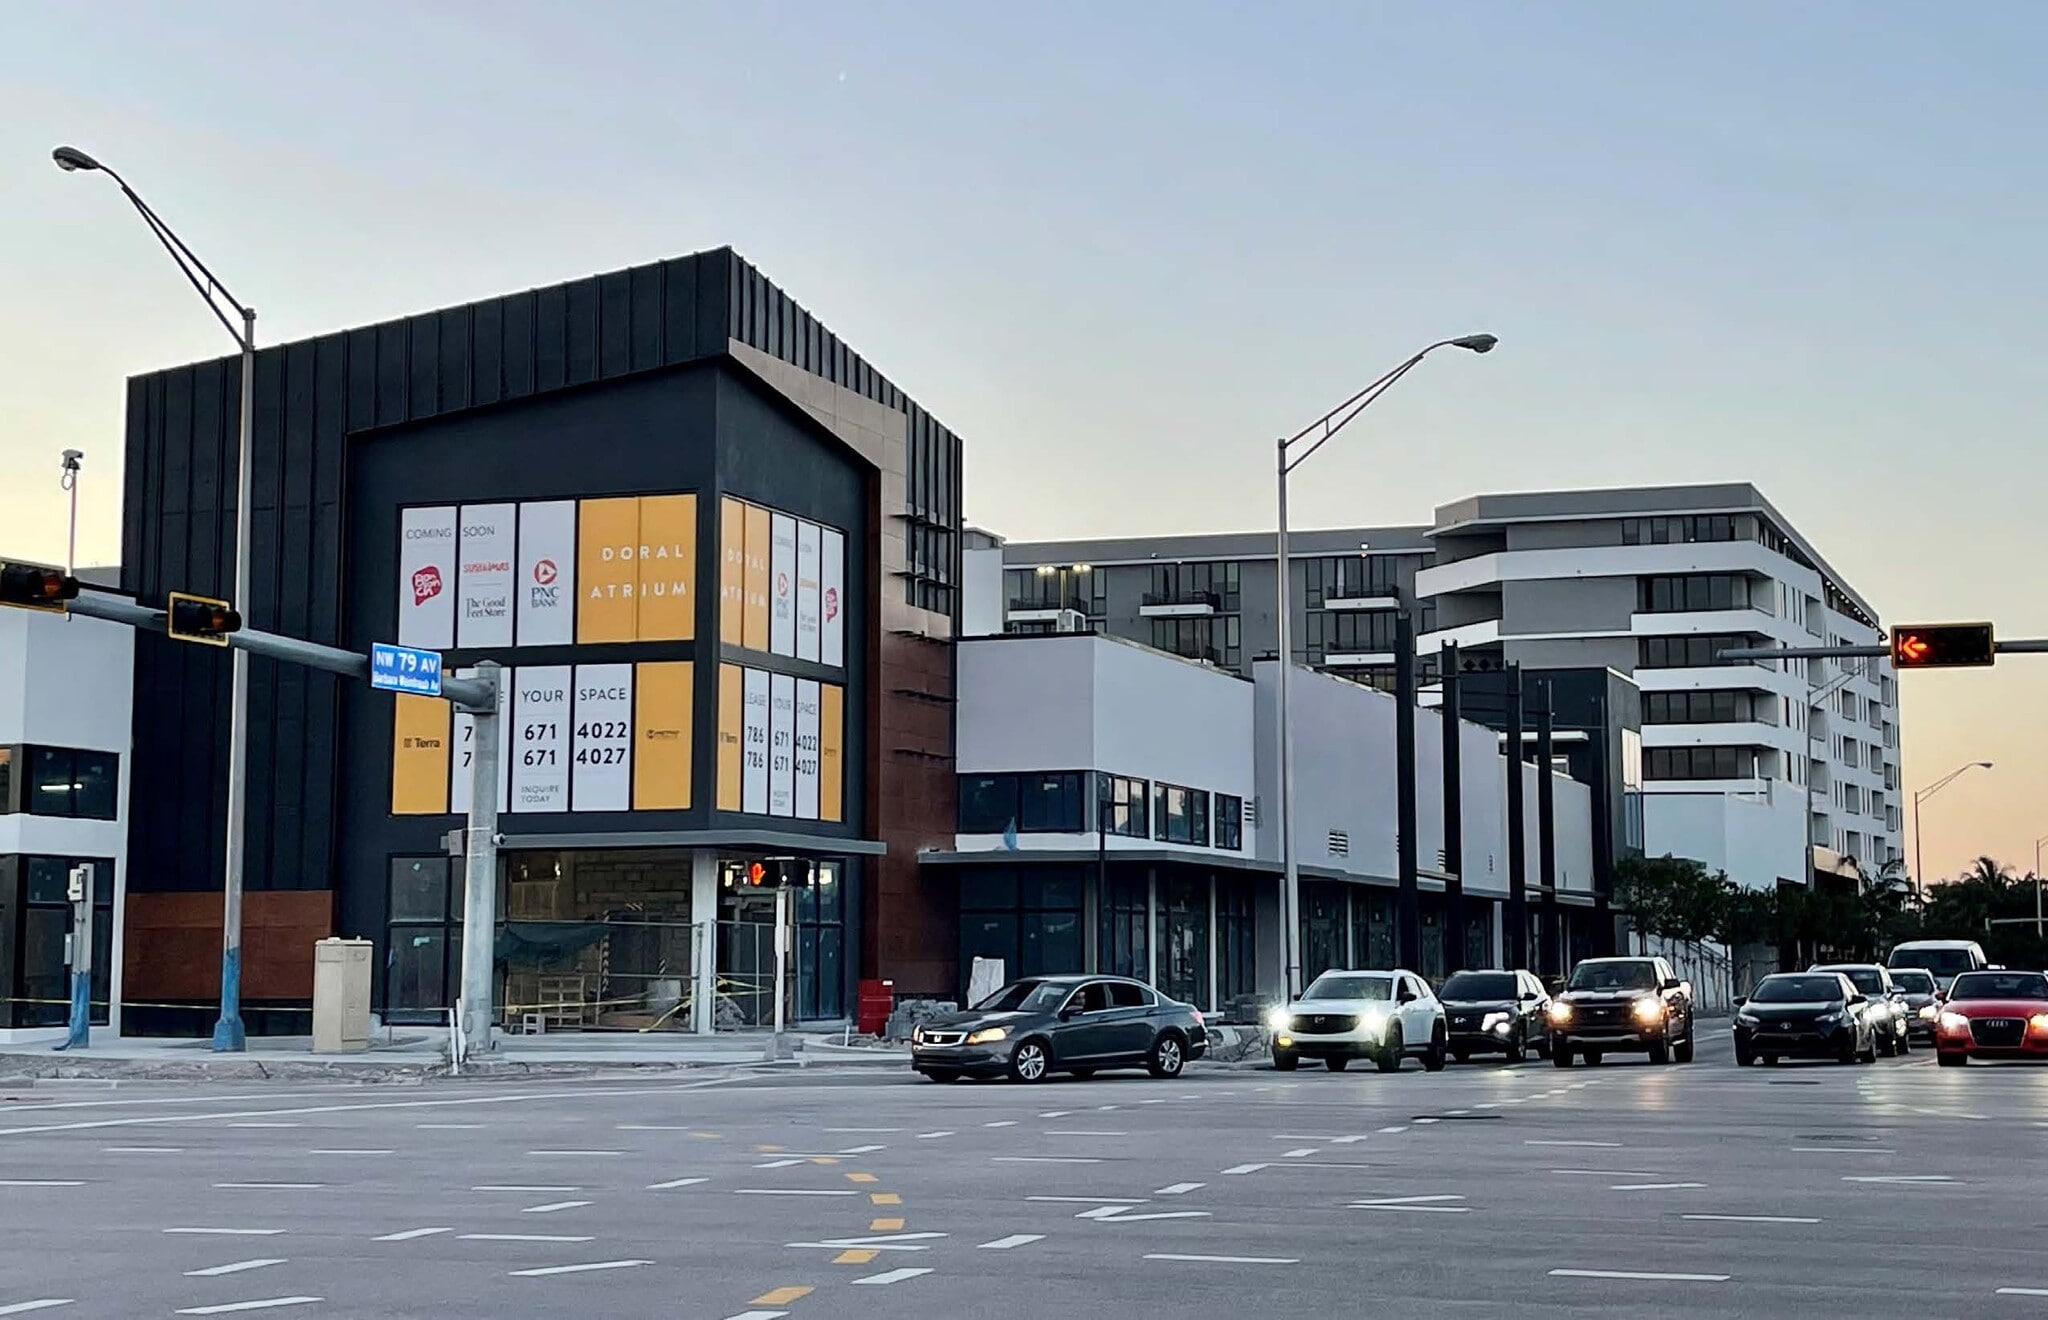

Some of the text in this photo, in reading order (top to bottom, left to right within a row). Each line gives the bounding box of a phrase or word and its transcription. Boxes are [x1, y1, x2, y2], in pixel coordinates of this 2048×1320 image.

[406, 526, 496, 540] COMING SOON
[601, 544, 684, 561] DORAL
[531, 586, 560, 598] PNC
[590, 581, 687, 600] ATRIUM
[375, 650, 437, 674] NW 79 AV
[522, 688, 627, 703] YOUR SPACE
[524, 723, 557, 741] 671
[577, 722, 627, 739] 4022
[746, 726, 764, 744] 786
[774, 730, 789, 747] 671
[795, 735, 817, 752] 4022
[414, 737, 440, 749] Terra
[523, 747, 626, 766] 671 4027
[746, 751, 817, 776] 786 671 4027
